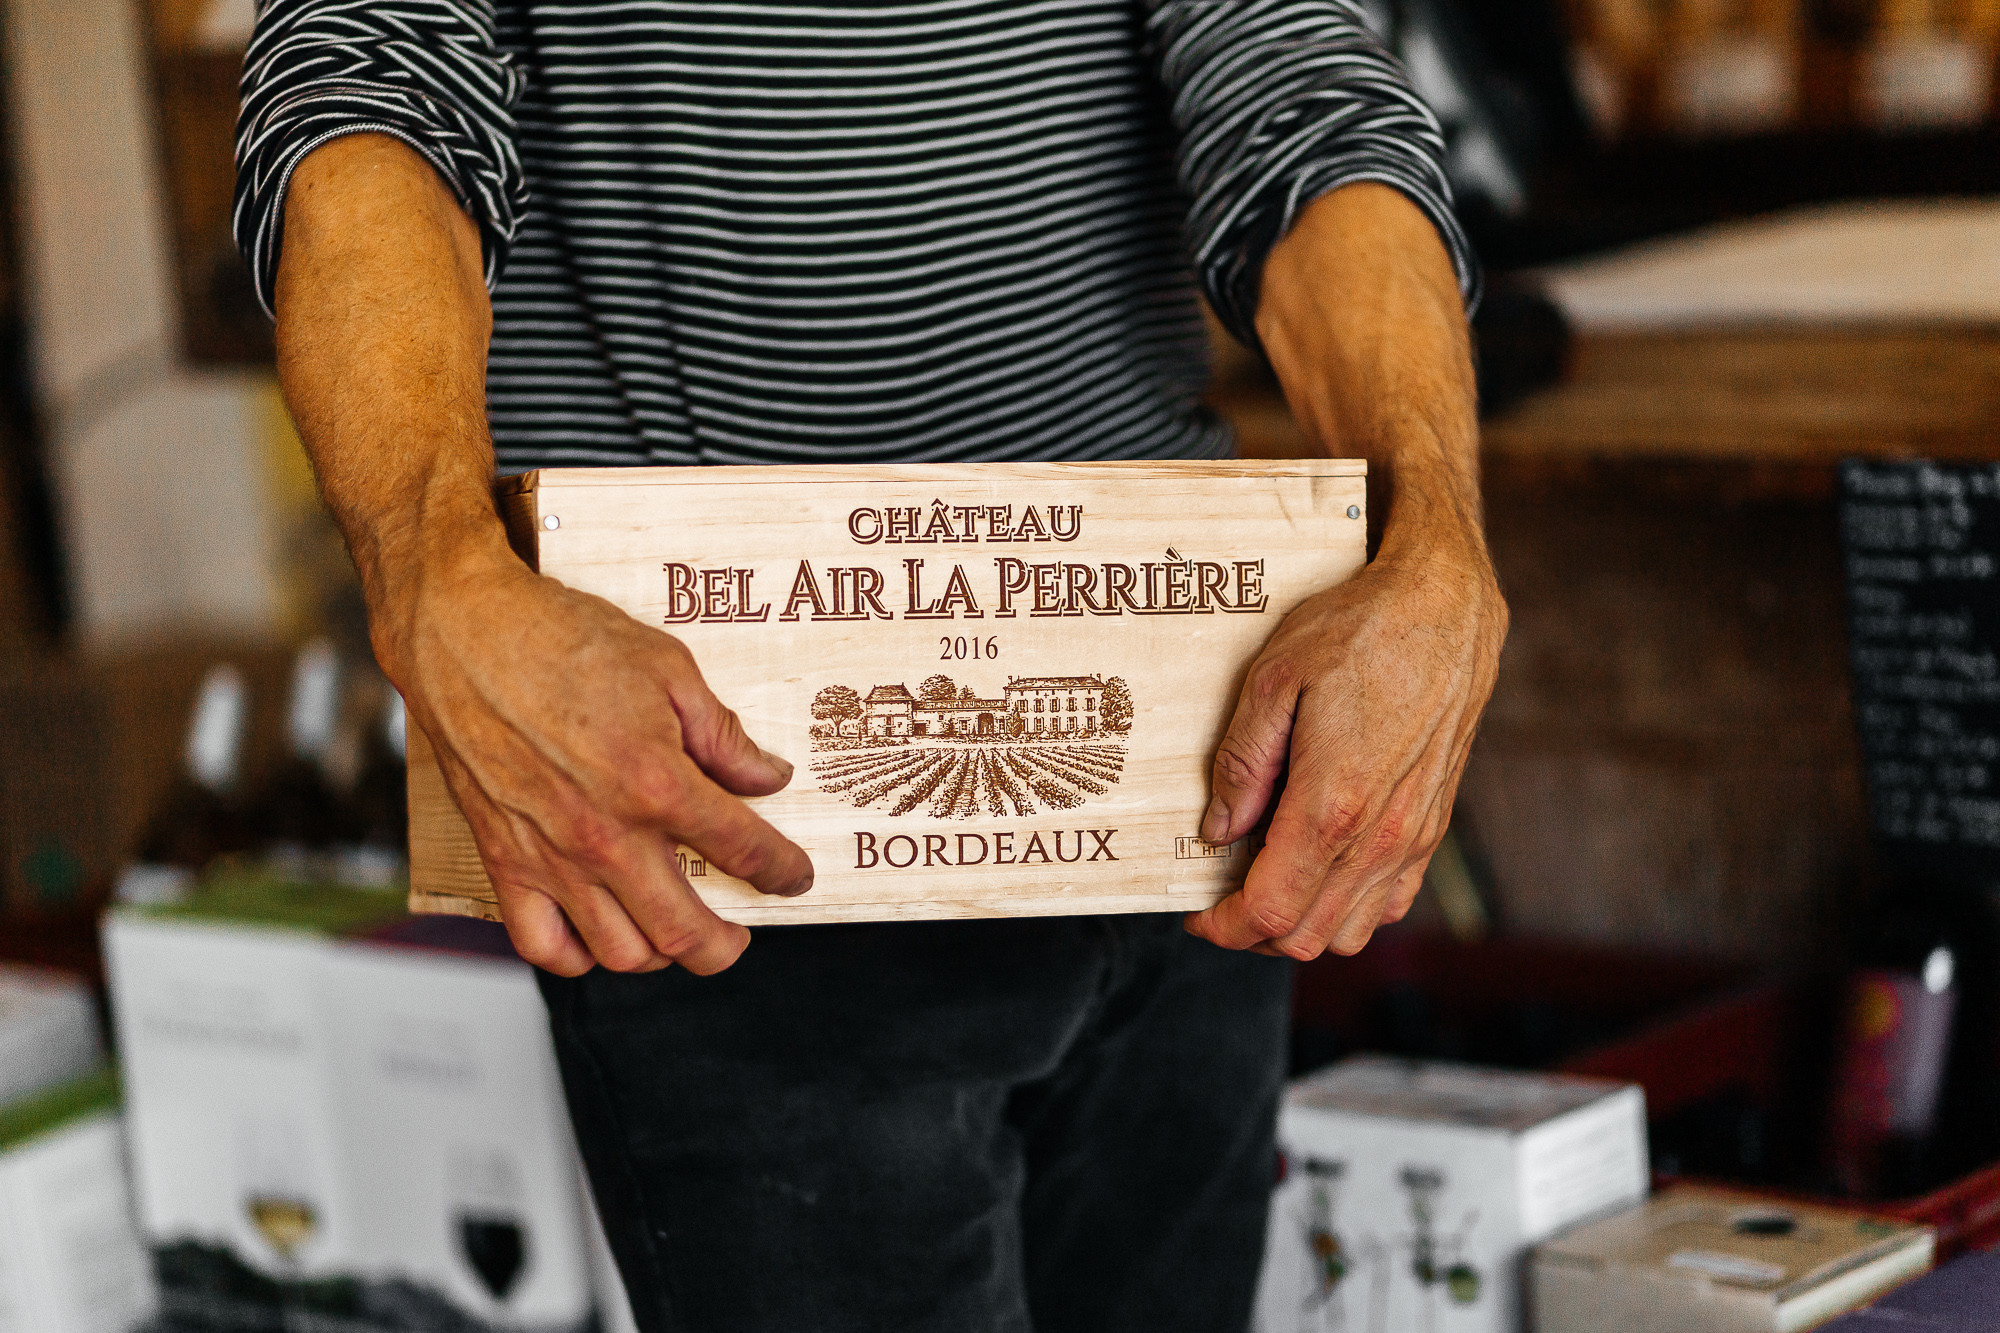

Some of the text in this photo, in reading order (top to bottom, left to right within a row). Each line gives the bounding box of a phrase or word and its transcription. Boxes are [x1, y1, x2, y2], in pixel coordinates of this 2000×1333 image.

[848, 498, 1083, 545] CHÂTEAU
[663, 546, 1269, 624] BEL AIR LA PERRIÈRE
[939, 635, 999, 660] 2016
[853, 829, 1120, 869] BORDEAUX
